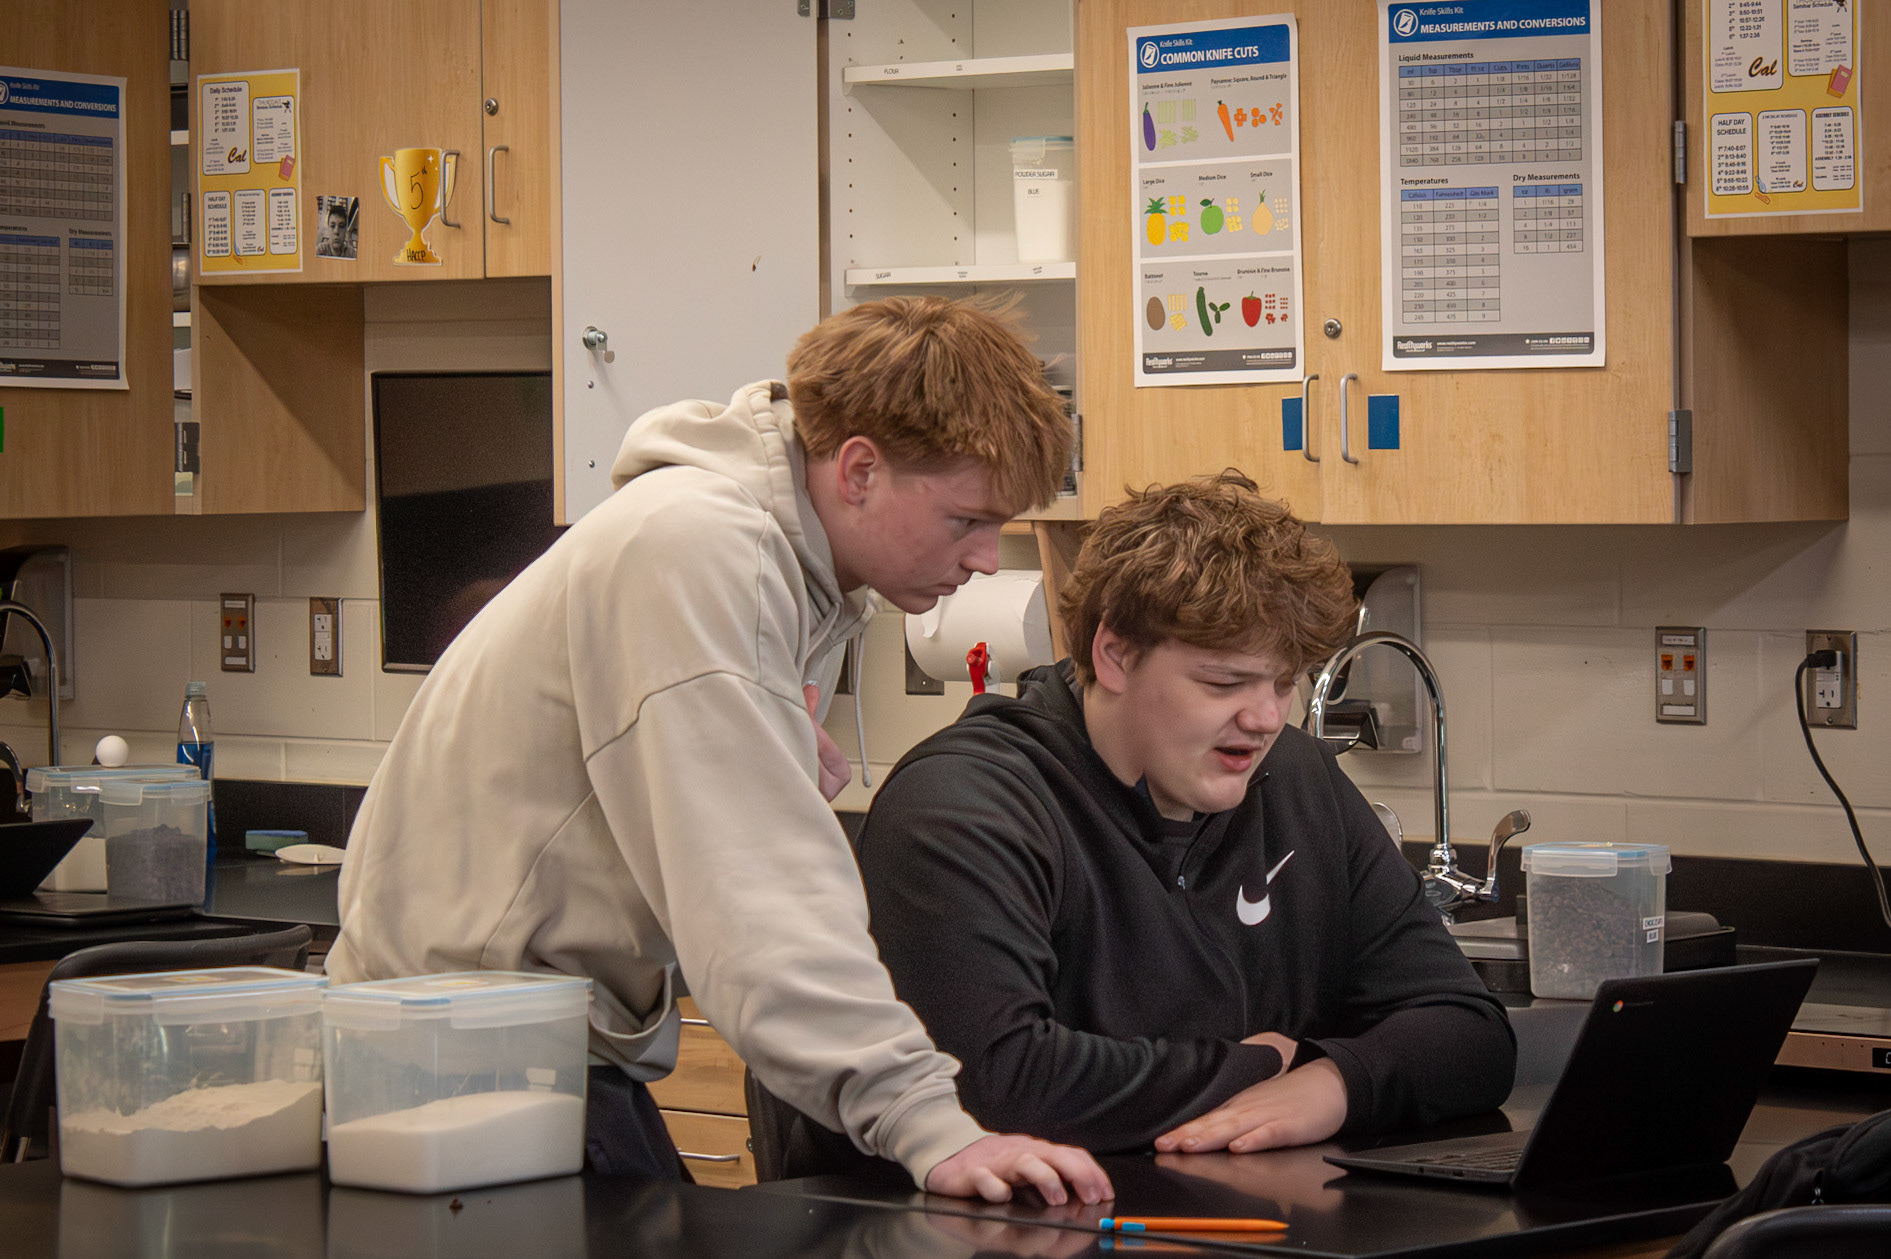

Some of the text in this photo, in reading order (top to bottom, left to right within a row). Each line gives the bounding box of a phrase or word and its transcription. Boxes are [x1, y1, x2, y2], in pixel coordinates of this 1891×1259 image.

[1420, 16, 1586, 33] MEASUREMENTS AND CONVERSIONS
[1161, 46, 1259, 64] COMMON KNIFE CUTS
[1398, 52, 1474, 62] Liquid Measurements
[1748, 57, 1777, 77] Cal
[10, 96, 116, 112] MEASUREMENTS AND CONVERSIONS
[228, 146, 247, 164] Cal
[1513, 174, 1526, 182] Dry
